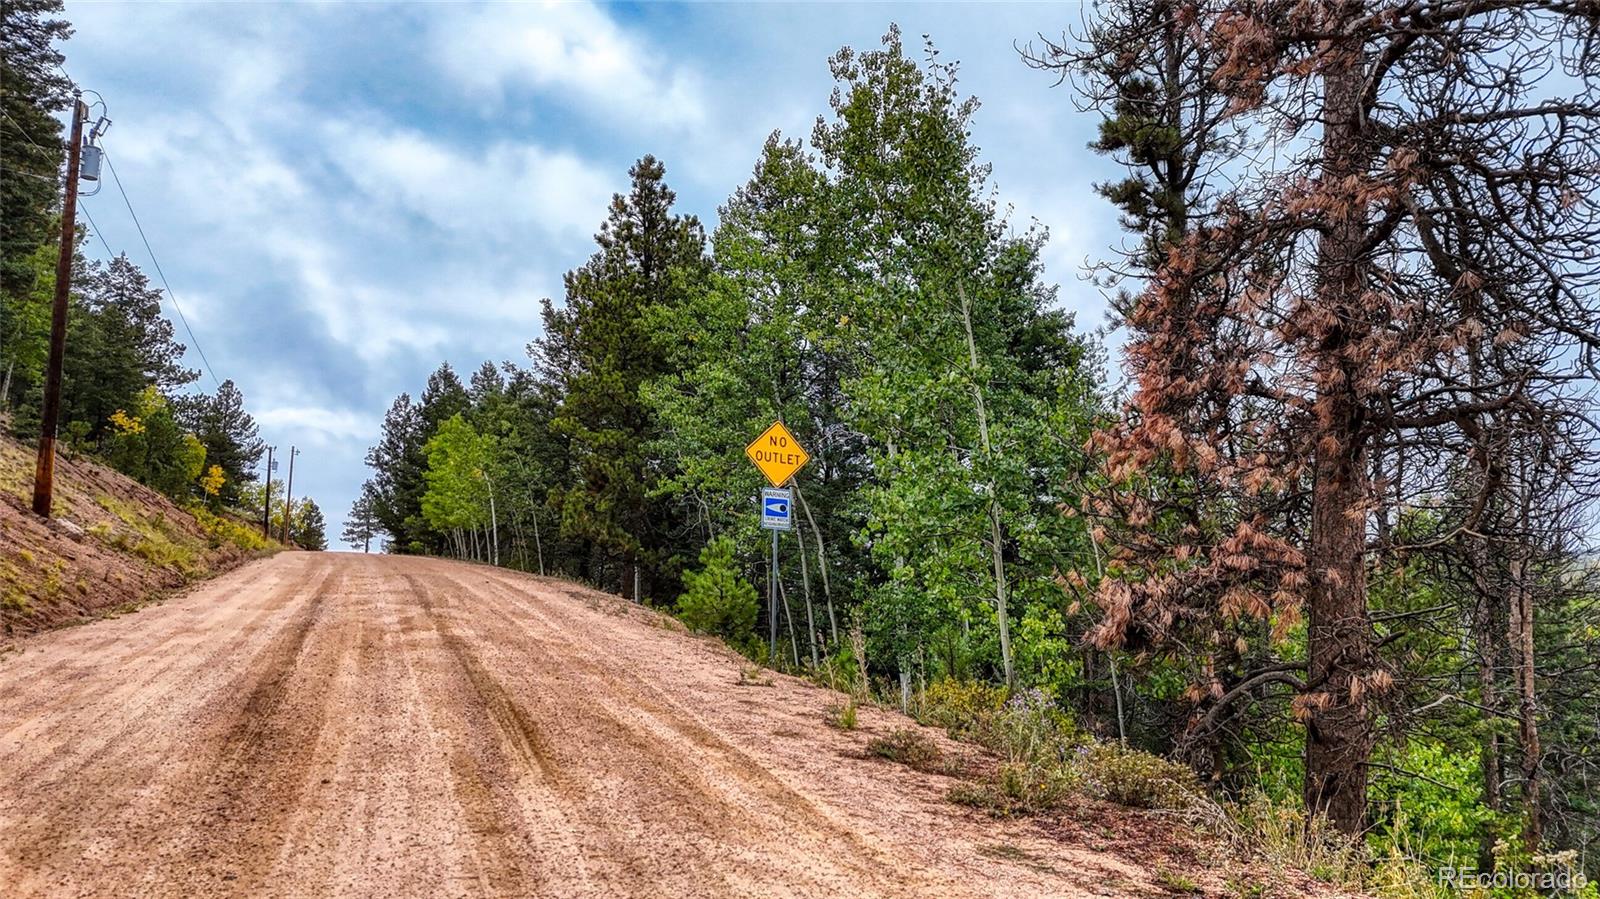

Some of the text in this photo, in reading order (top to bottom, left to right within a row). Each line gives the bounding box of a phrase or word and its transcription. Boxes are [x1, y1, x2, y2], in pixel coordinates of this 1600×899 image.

[769, 436, 787, 448] NO
[755, 450, 801, 465] OUTLET
[764, 491, 790, 499] WARNING
